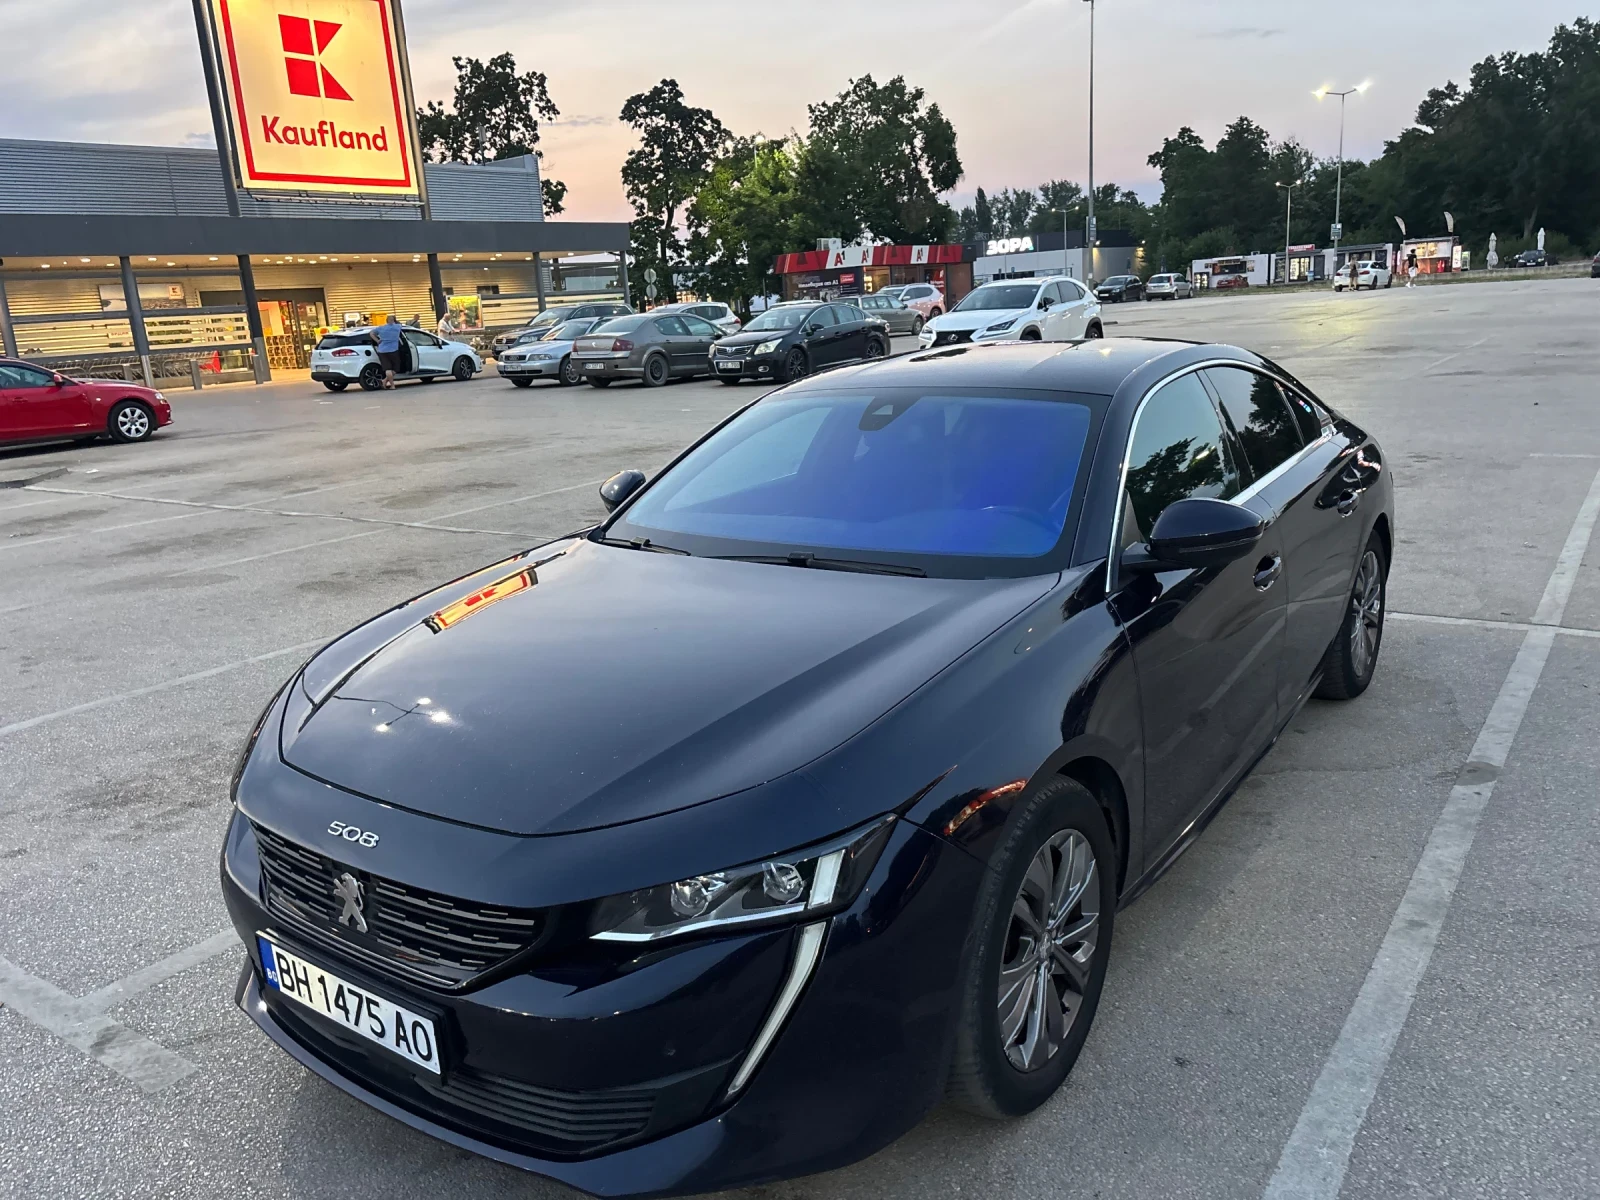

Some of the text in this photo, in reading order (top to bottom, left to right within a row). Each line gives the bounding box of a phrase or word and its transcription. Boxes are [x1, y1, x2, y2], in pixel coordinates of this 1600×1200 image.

[261, 115, 388, 151] Kaufland
[986, 236, 1034, 255] ЗОРА
[834, 250, 846, 266] A1
[861, 248, 870, 263] A1
[916, 248, 923, 262] A1
[327, 820, 380, 848] 508
[266, 968, 278, 983] BG
[276, 951, 433, 1062] BH 1475 AO
